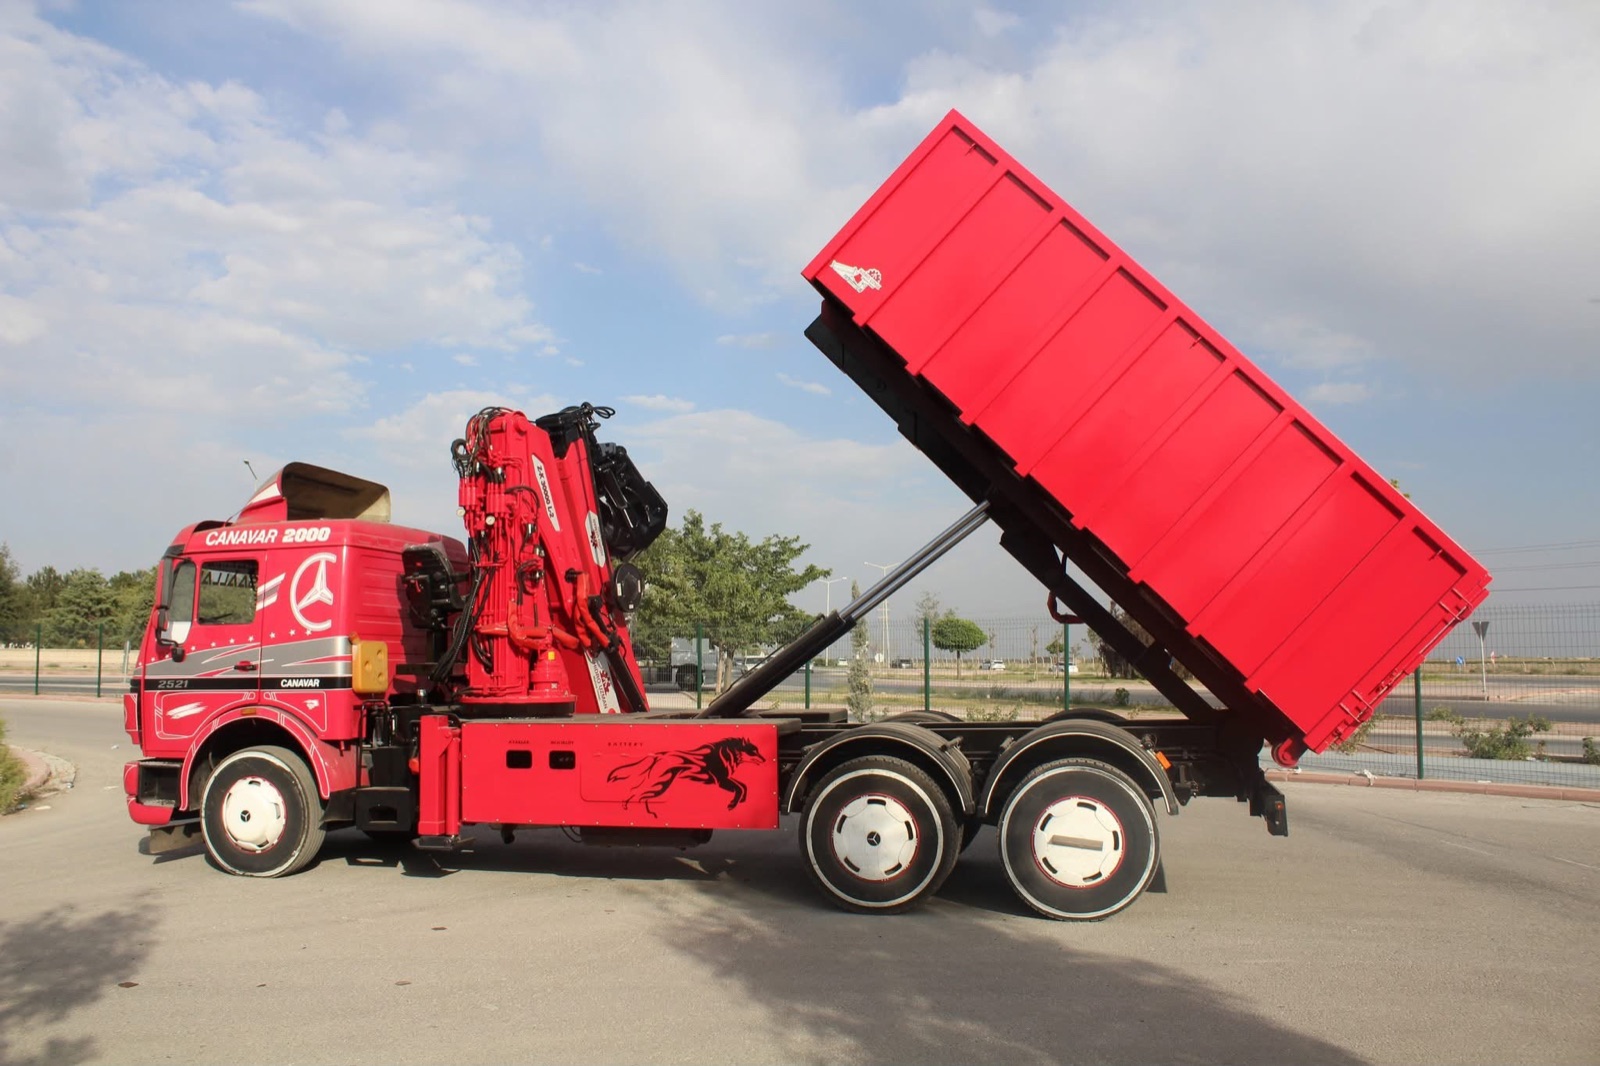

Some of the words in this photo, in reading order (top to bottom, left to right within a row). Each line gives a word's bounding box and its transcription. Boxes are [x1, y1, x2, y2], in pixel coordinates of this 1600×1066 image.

[541, 481, 551, 504] 30000
[205, 529, 278, 546] CANAVAR
[282, 527, 331, 543] 2000
[158, 680, 189, 689] 2521
[280, 678, 320, 688] CANAVAR
